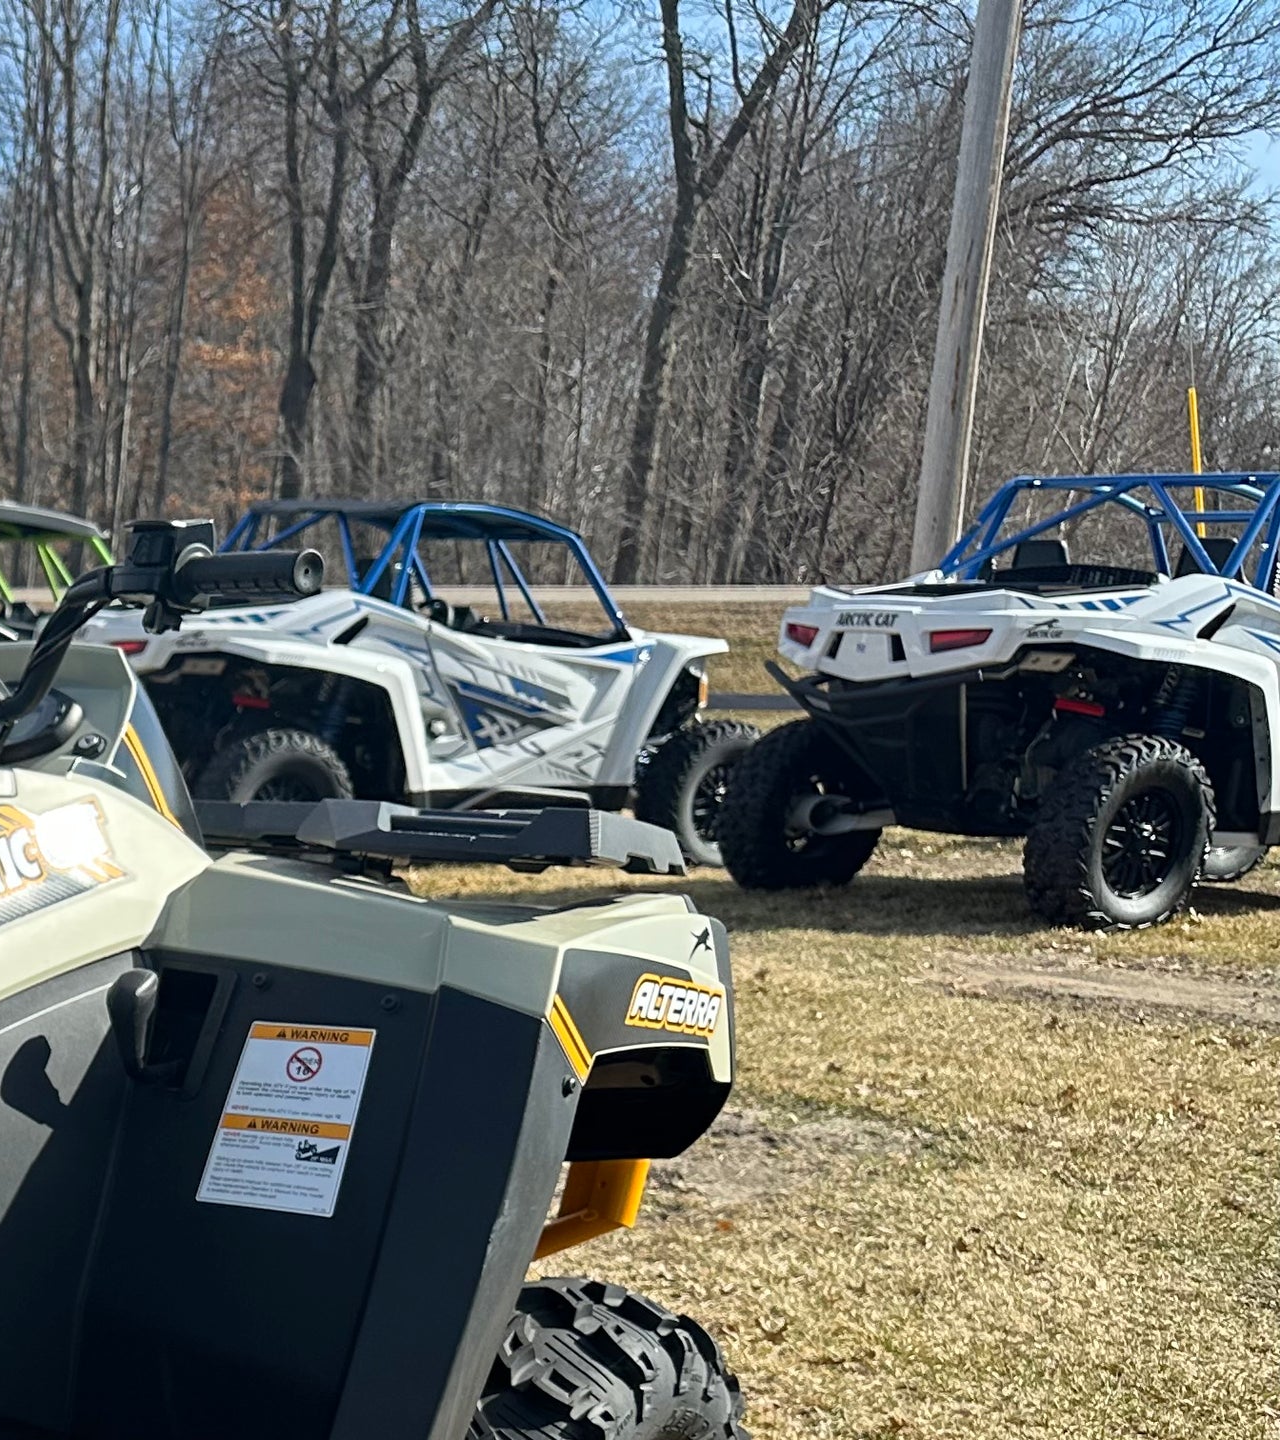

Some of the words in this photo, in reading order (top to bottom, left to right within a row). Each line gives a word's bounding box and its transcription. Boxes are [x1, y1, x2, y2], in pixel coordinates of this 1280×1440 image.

[836, 612, 874, 627] ARCTIC
[874, 613, 899, 627] CAT
[630, 981, 721, 1033] ALTERRA
[289, 1029, 350, 1043] WARNING
[260, 1120, 320, 1135] WARNING
